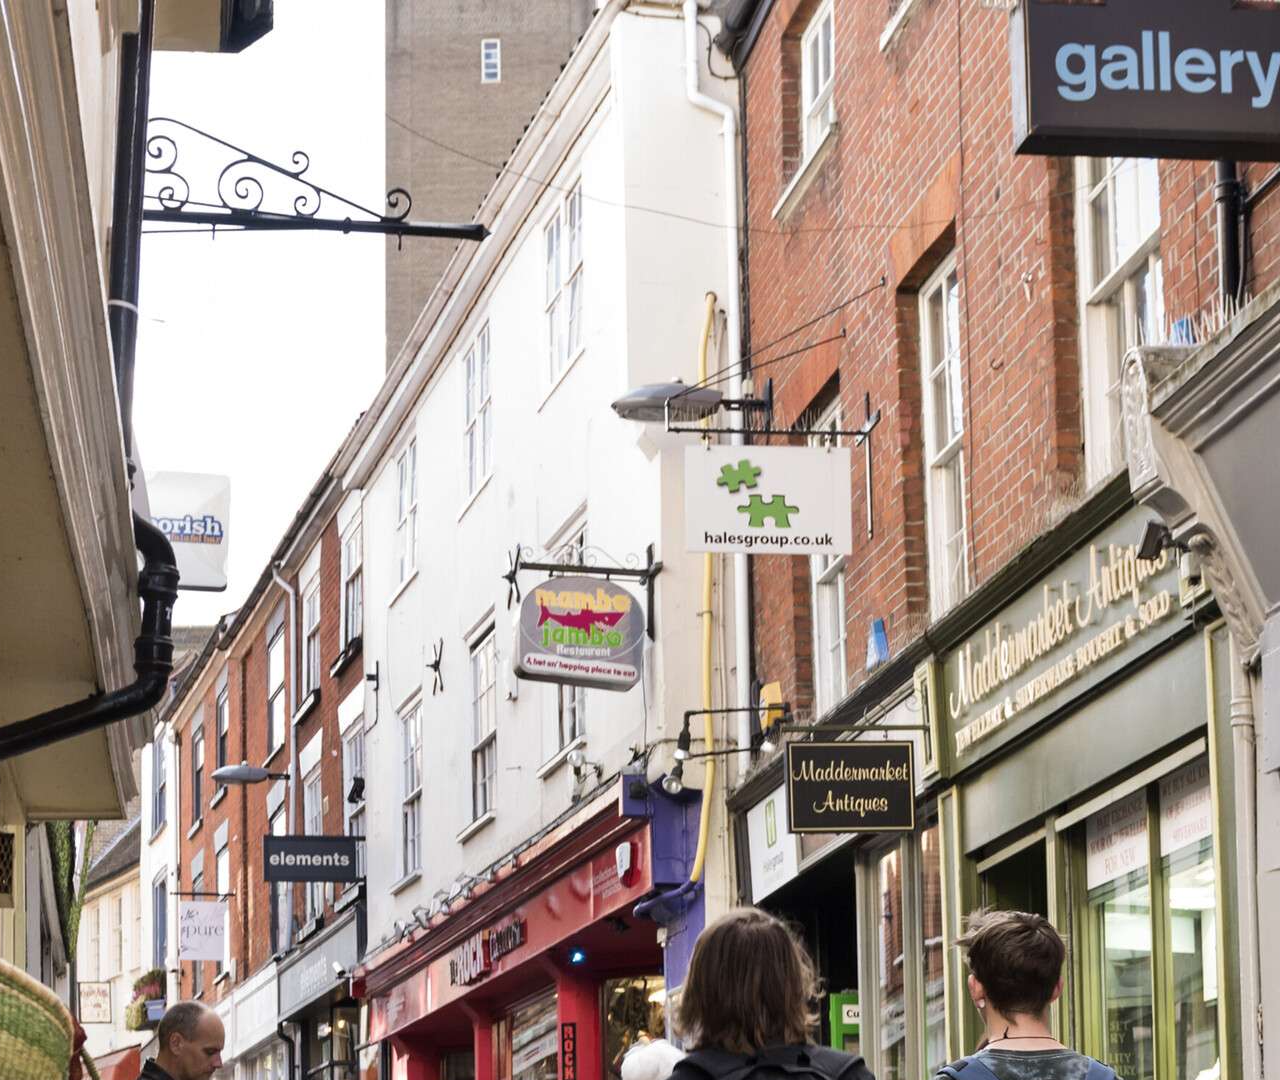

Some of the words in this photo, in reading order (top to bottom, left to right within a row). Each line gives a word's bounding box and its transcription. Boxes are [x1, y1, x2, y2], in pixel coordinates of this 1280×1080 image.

[704, 531, 833, 548] halesgroup.co.uk
[535, 587, 632, 612] mambo
[1139, 589, 1170, 630] SOLD
[542, 621, 625, 648] jambo
[949, 579, 1073, 720] Maddermarket
[792, 759, 909, 782] Maddermarket
[812, 789, 889, 818] Antiques
[269, 851, 350, 867] elements
[563, 1025, 574, 1080] ROCK
